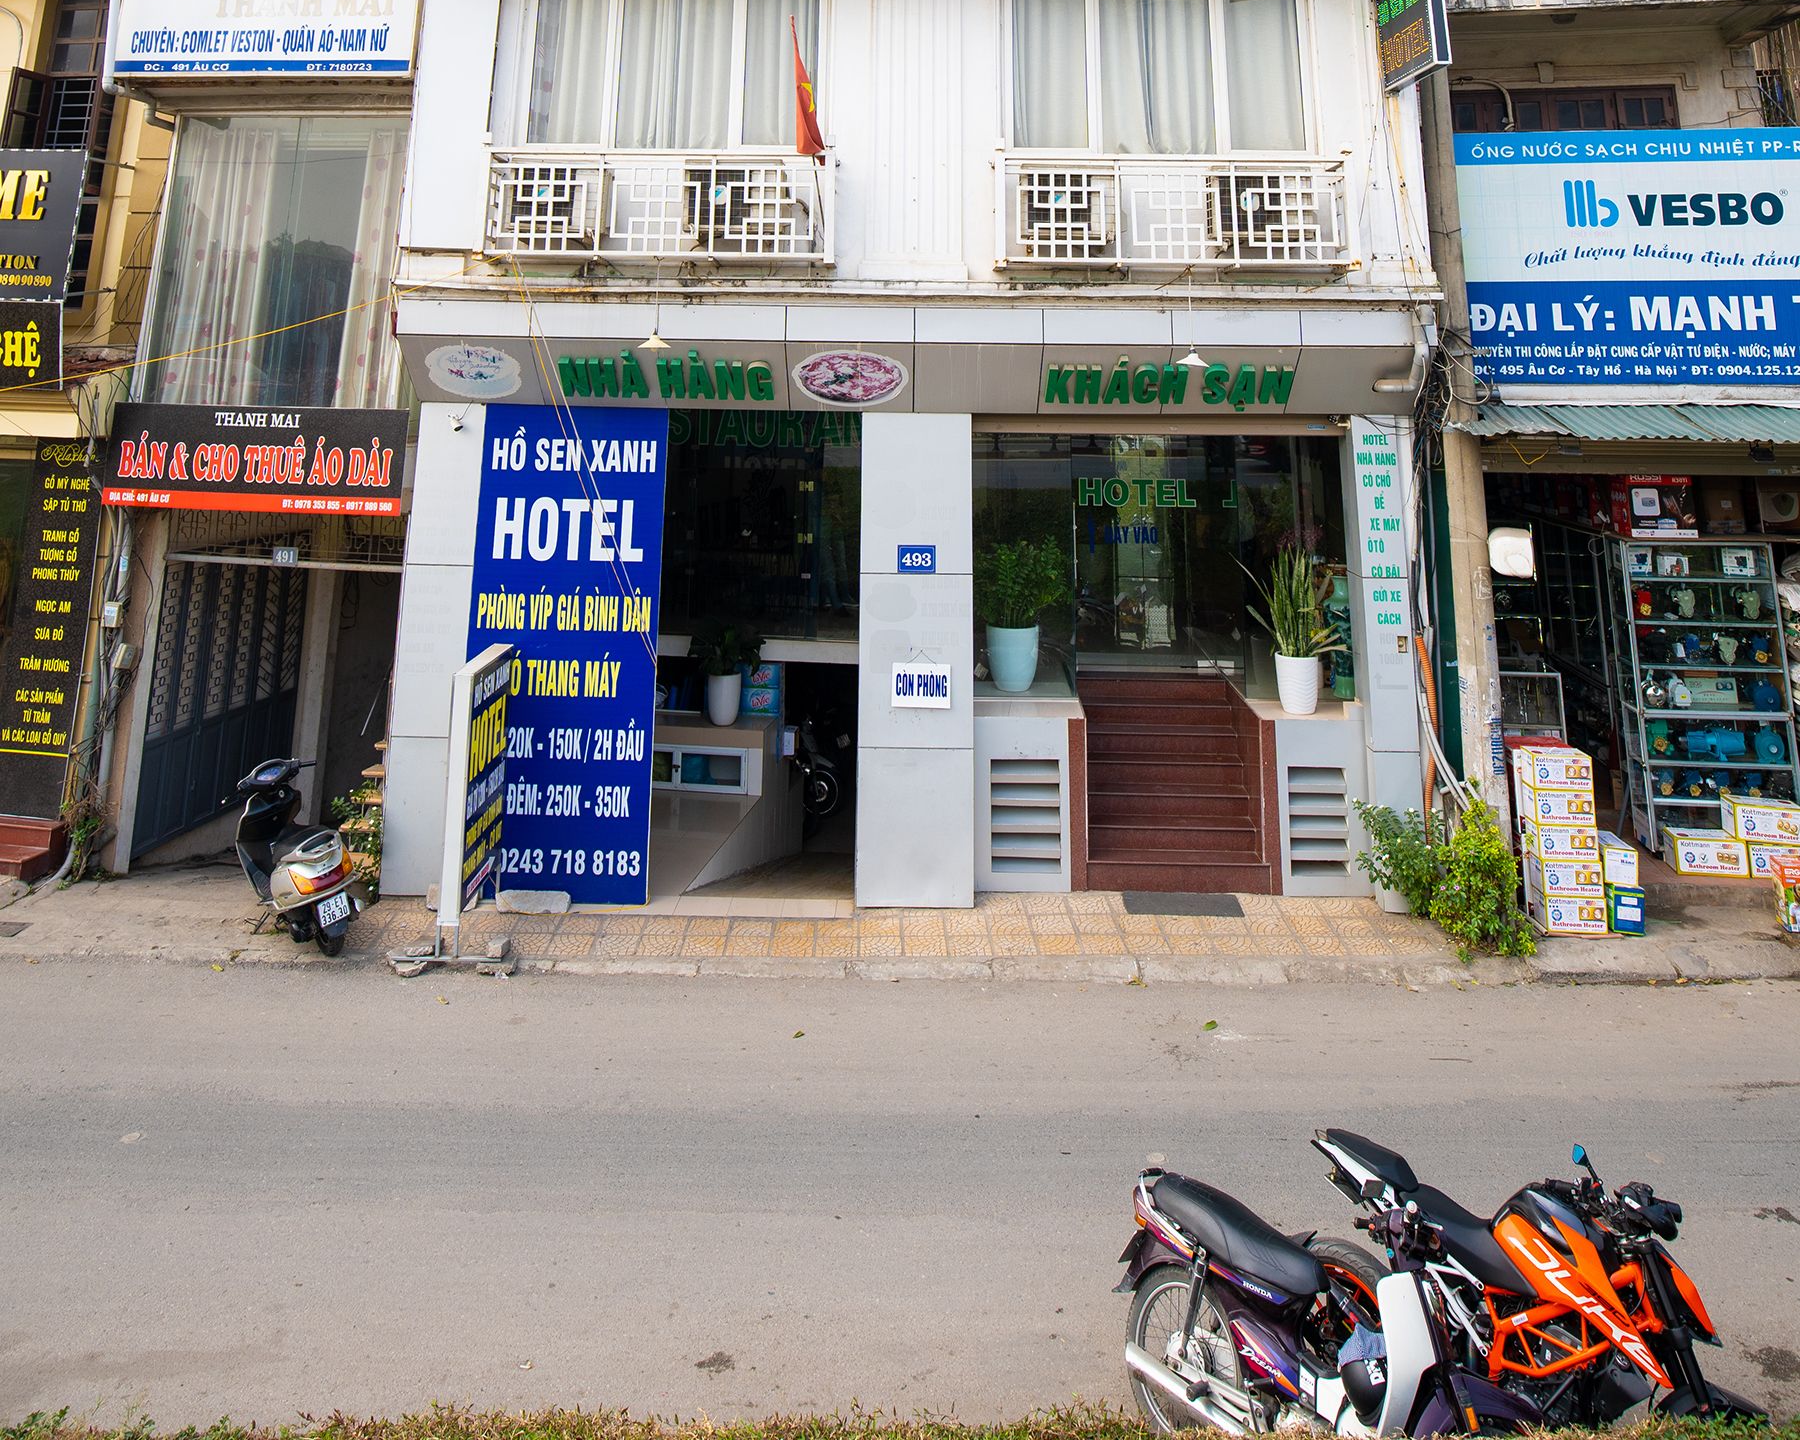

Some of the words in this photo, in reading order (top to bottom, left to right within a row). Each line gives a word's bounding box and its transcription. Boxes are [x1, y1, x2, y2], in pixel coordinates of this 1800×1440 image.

[181, 30, 228, 53] COMLET
[230, 29, 275, 53] VESTON
[282, 24, 314, 56] QUẦN
[370, 22, 391, 52] NỮ
[1383, 18, 1429, 75] HOTEL
[144, 63, 164, 71] ĐC:
[172, 62, 189, 71] 491
[192, 60, 210, 71] ÂU
[307, 62, 326, 71] ĐT:
[328, 62, 372, 71] 7180723
[1471, 141, 1514, 159] ỐNG
[1522, 141, 1578, 159] NƯỚC
[1586, 142, 1638, 159] SẠCH
[1645, 141, 1691, 158] CHỊU
[1699, 138, 1755, 157] NHIỆT
[1762, 140, 1800, 153] PP-R
[1627, 192, 1785, 226] VESBO
[1525, 247, 1567, 269] Chất
[1574, 245, 1626, 261] lượng
[1633, 243, 1693, 264] khẳng
[1701, 250, 1744, 268] định
[1752, 250, 1800, 269] đẳng
[1469, 303, 1538, 338] ĐẠI
[1552, 295, 1616, 332] LÝ:
[1629, 295, 1777, 339] MẠNH
[1515, 346, 1531, 357] THI
[1534, 343, 1562, 358] CÔNG
[1564, 341, 1584, 357] LẮP
[1587, 344, 1607, 360] ĐẶT
[1611, 346, 1639, 357] CUNG
[1641, 341, 1661, 357] CẤP
[1664, 343, 1684, 359] VẬT
[1687, 344, 1701, 357] TƯ
[1704, 343, 1729, 359] ĐIỆN
[1773, 342, 1796, 357] MÁY
[558, 349, 649, 399] NHÀ
[656, 350, 776, 401] HÀNG
[1499, 364, 1524, 375] 495
[1528, 362, 1544, 375] Âu
[1548, 364, 1566, 375] Cơ
[1577, 364, 1600, 377] Tây
[1605, 362, 1621, 375] Hồ
[1635, 363, 1651, 375] Hà
[1656, 363, 1677, 377] Nội
[1692, 364, 1713, 375] ĐT:
[1717, 364, 1800, 376] 0904.125.12
[1045, 354, 1190, 405] KHÁCH
[1203, 364, 1294, 412] SẠN
[215, 412, 268, 428] THANH
[271, 413, 301, 429] MAI
[492, 426, 527, 471] HỒ
[534, 437, 583, 471] SEN
[590, 439, 657, 473] XANH
[1362, 434, 1389, 446] HOTEL
[118, 430, 168, 480] BÁN
[192, 443, 240, 483] CHO
[244, 434, 306, 484] THUÊ
[308, 435, 344, 486] ÁO
[346, 436, 393, 487] DÀI
[1357, 450, 1373, 466] NHÀ
[327, 501, 340, 510] 855
[1078, 478, 1197, 508] HOTEL
[42, 529, 67, 543] TRANH
[492, 496, 644, 563] HOTEL
[1370, 517, 1380, 531] XE
[1383, 515, 1400, 531] MÁY
[276, 550, 294, 563] 491
[902, 553, 931, 566] 493
[32, 567, 58, 580] PHONG
[60, 566, 80, 582] THỦY
[58, 601, 71, 614] AM
[477, 584, 526, 630] PHÒNG
[530, 585, 553, 630] VÍP
[557, 585, 580, 631] GIÁ
[584, 586, 619, 632] BÌNH
[622, 587, 651, 633] DÂN
[1390, 590, 1402, 603] XE
[43, 658, 70, 672] HƯƠNG
[527, 659, 580, 697] THANG
[584, 651, 621, 698] MÁY
[896, 669, 914, 696] CÒN
[917, 670, 948, 698] PHÒNG
[469, 693, 507, 783] HOTEL
[548, 728, 583, 760] 150K
[593, 729, 612, 761] 2H
[616, 718, 645, 762] ĐẦU
[507, 776, 542, 816] ĐÊM:
[545, 784, 582, 817] 250K
[595, 786, 631, 818] 350K
[500, 848, 544, 875] 0243
[551, 849, 586, 876] 718
[592, 850, 641, 877] 8183
[1242, 1280, 1273, 1299] HONDA
[1508, 1236, 1663, 1378] DUKE
